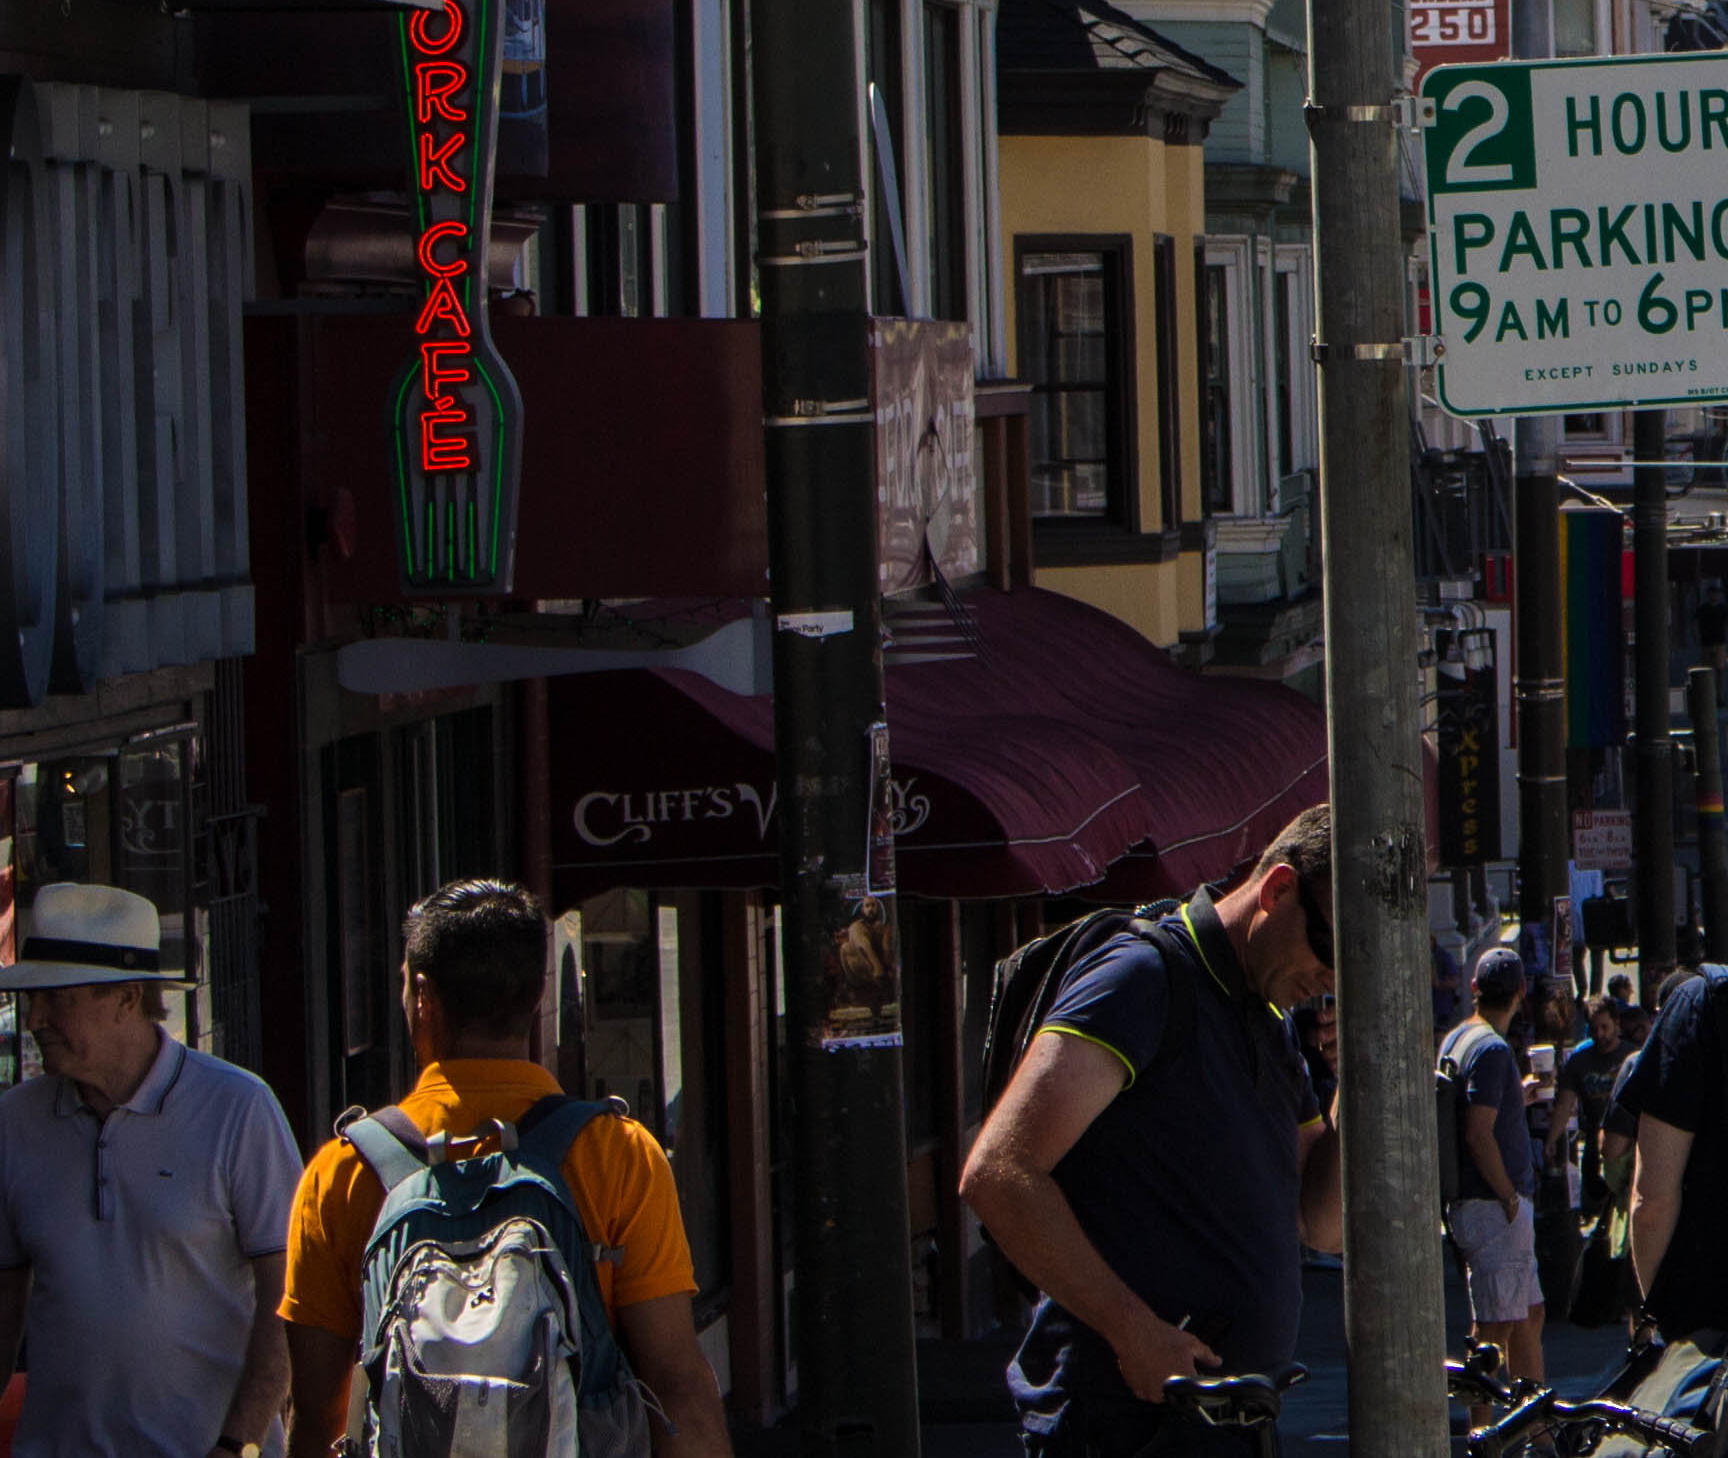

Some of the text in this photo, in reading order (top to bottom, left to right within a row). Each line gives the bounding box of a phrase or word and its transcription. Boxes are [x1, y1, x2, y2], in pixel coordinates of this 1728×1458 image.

[1442, 80, 1513, 184] 2
[1449, 281, 1570, 344] 9AM
[1584, 299, 1622, 327] TO
[416, 221, 470, 472] CAFÉ
[1525, 359, 1698, 381] EXCEPT SUNDAYS
[573, 788, 734, 846] CLIFF'S
